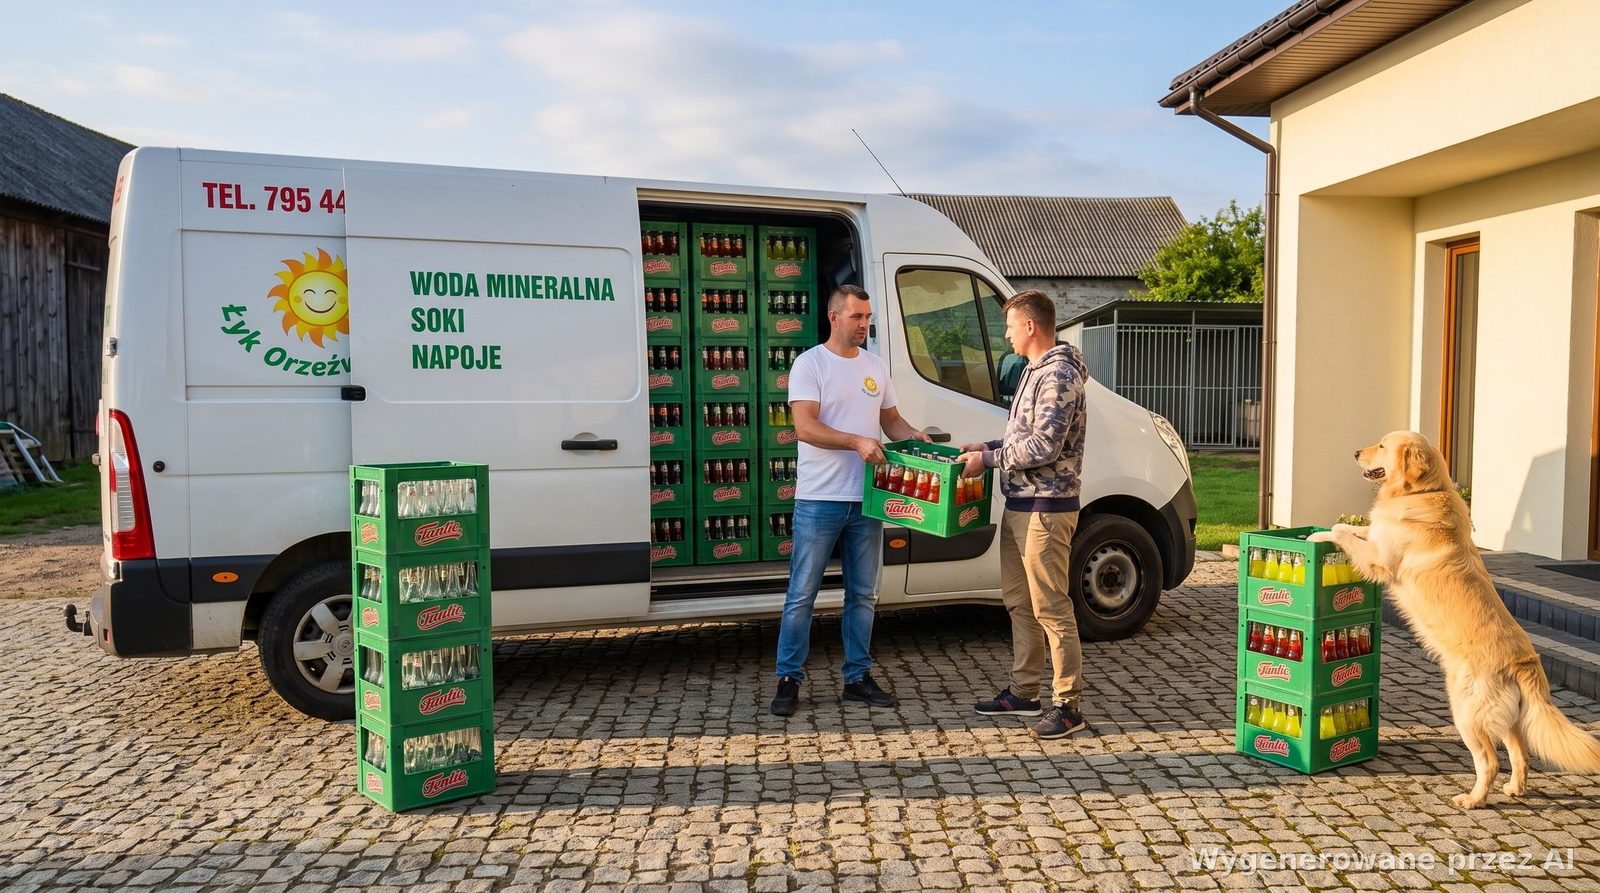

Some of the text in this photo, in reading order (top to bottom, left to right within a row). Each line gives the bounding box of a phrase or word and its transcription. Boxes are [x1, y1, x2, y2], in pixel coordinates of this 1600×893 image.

[202, 182, 346, 214] TEL. 795 44
[410, 271, 615, 301] WODA MINERALNA
[221, 304, 261, 353] Łyk
[411, 307, 465, 333] SOKI
[412, 344, 502, 370] NAPOJE
